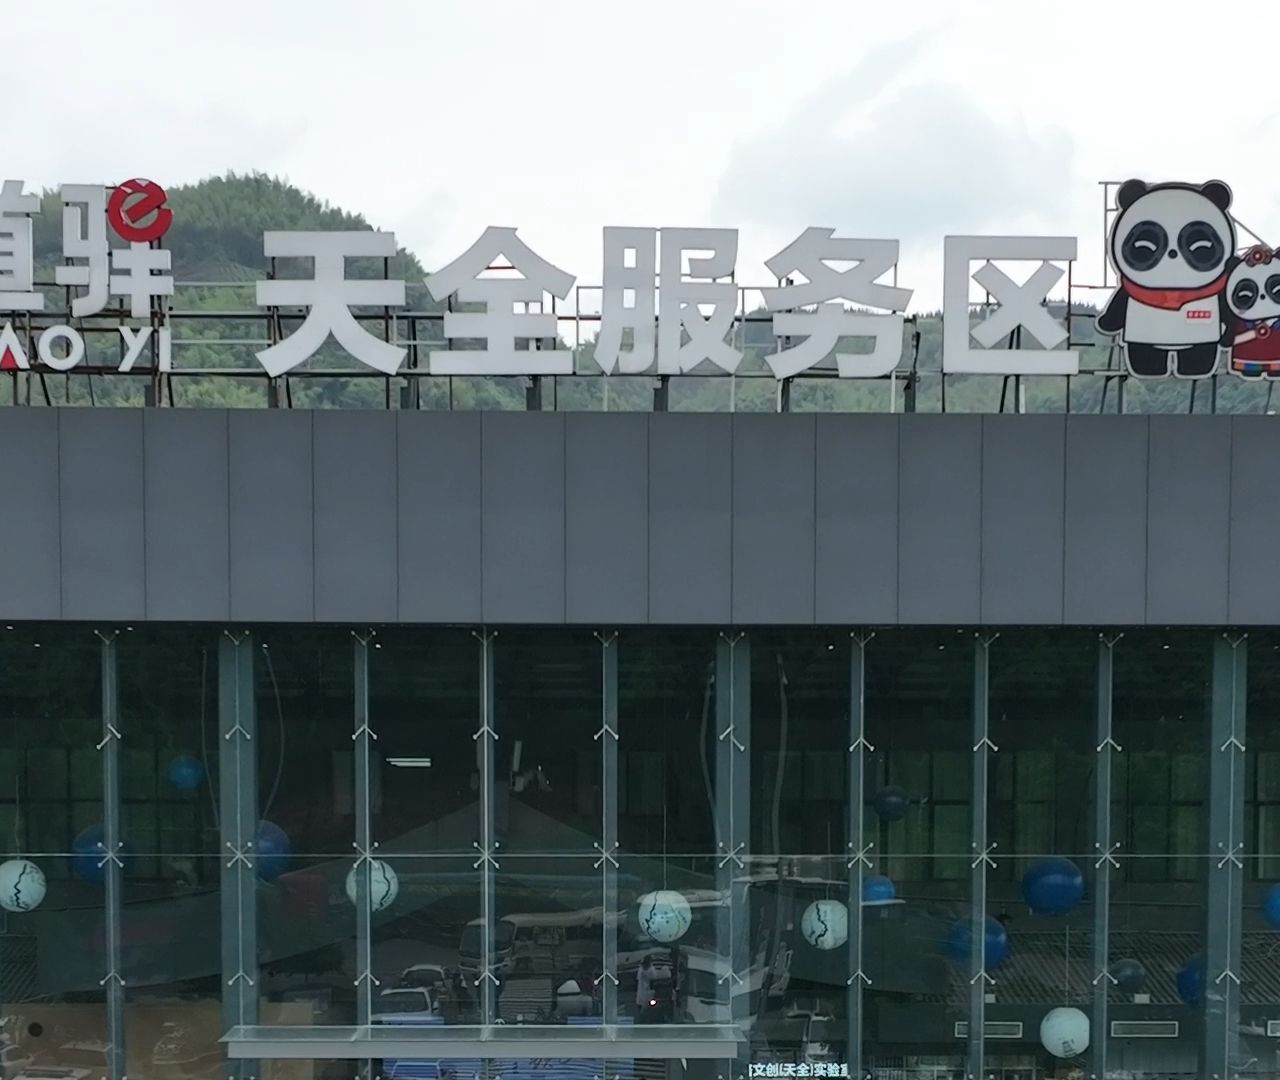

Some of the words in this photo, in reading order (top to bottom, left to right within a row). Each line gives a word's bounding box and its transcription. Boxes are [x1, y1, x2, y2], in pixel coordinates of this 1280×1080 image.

[118, 324, 171, 373] YI
[256, 226, 1079, 378] 天全服务区
